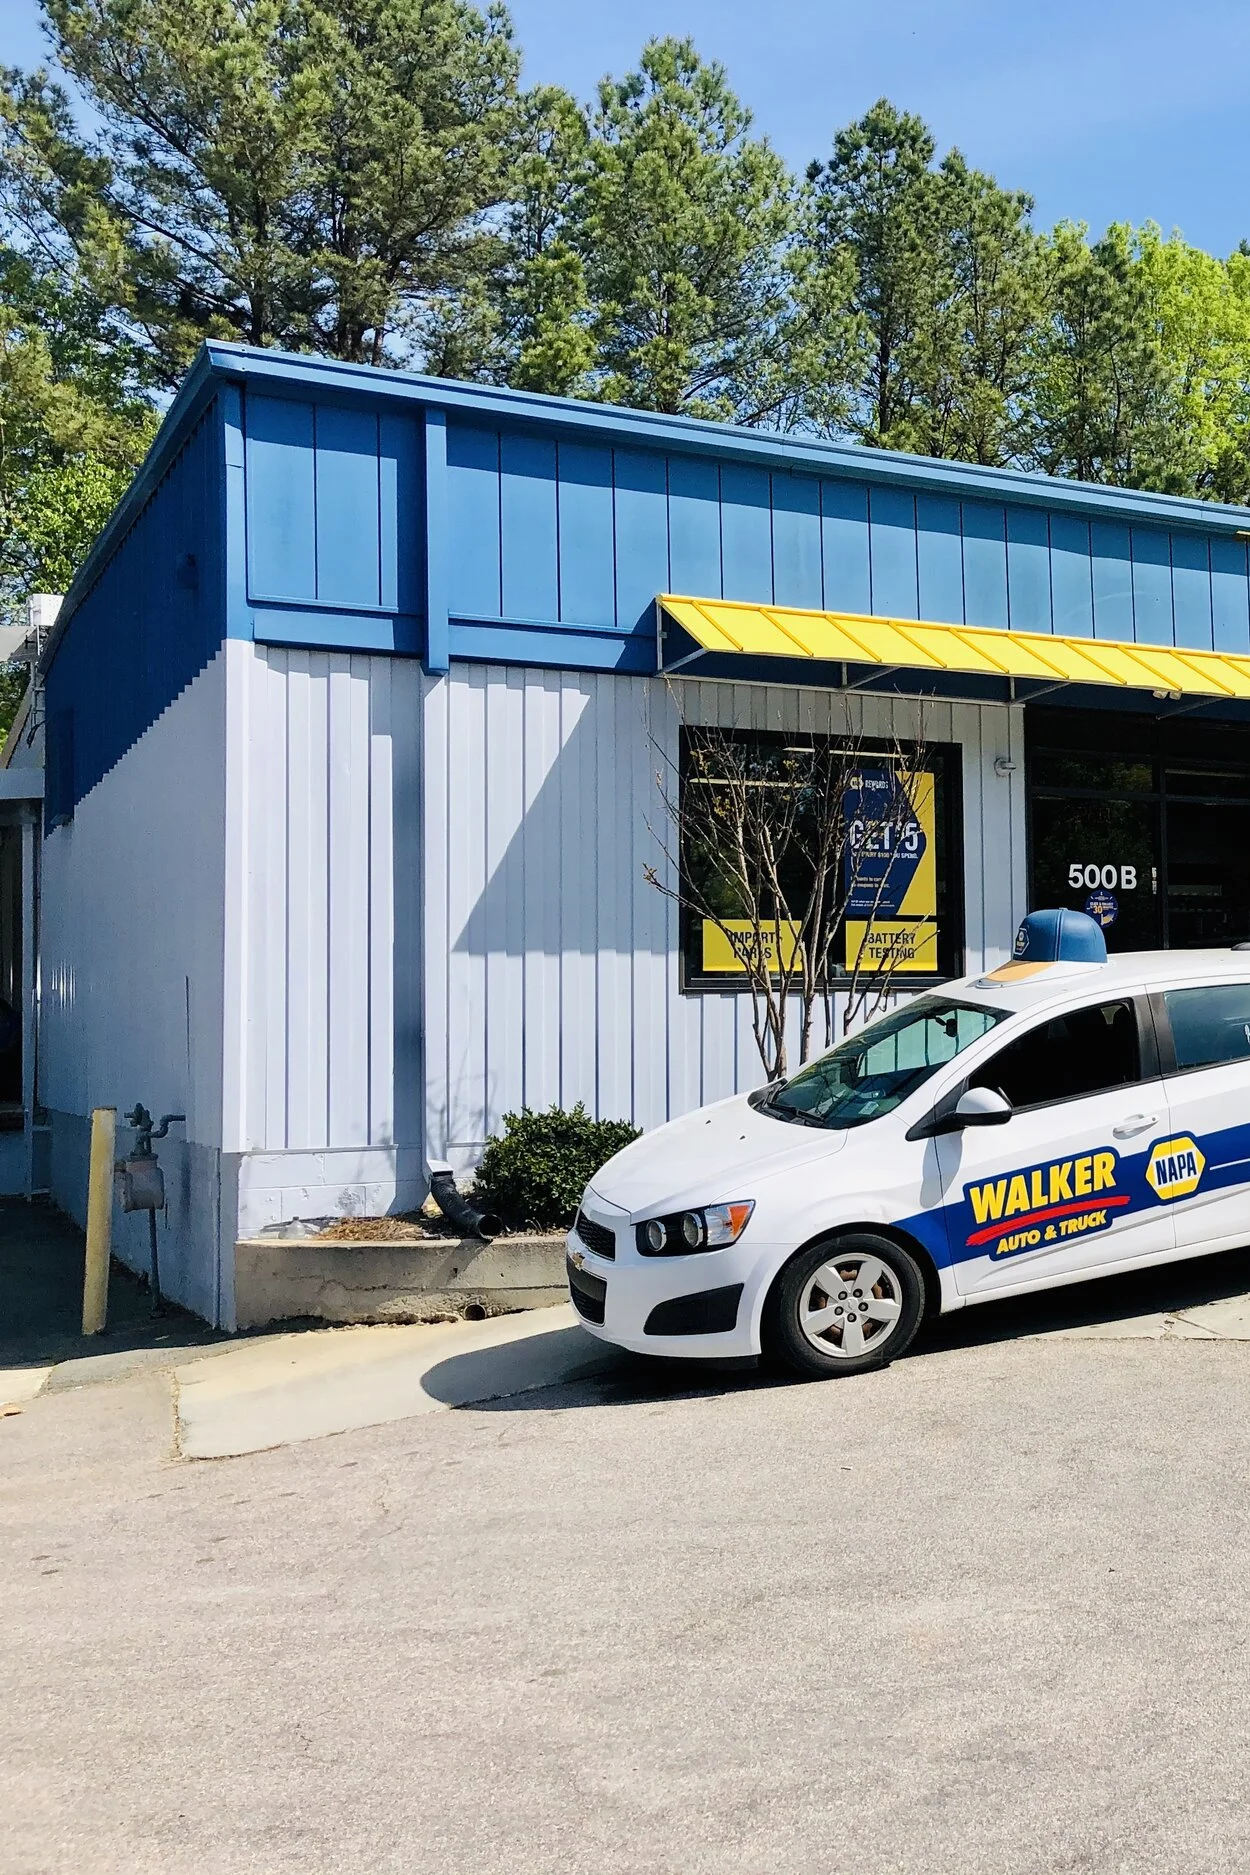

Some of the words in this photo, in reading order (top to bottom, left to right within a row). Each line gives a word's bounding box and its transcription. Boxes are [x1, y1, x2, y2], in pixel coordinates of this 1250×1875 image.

[867, 932, 916, 945] BATTERY
[868, 946, 916, 959] TESTING
[1155, 1151, 1197, 1186] NAPA
[968, 1151, 1117, 1225] WALKER
[996, 1227, 1042, 1255] AUTO
[1044, 1222, 1057, 1240] &
[1059, 1209, 1108, 1237] TRUCK
